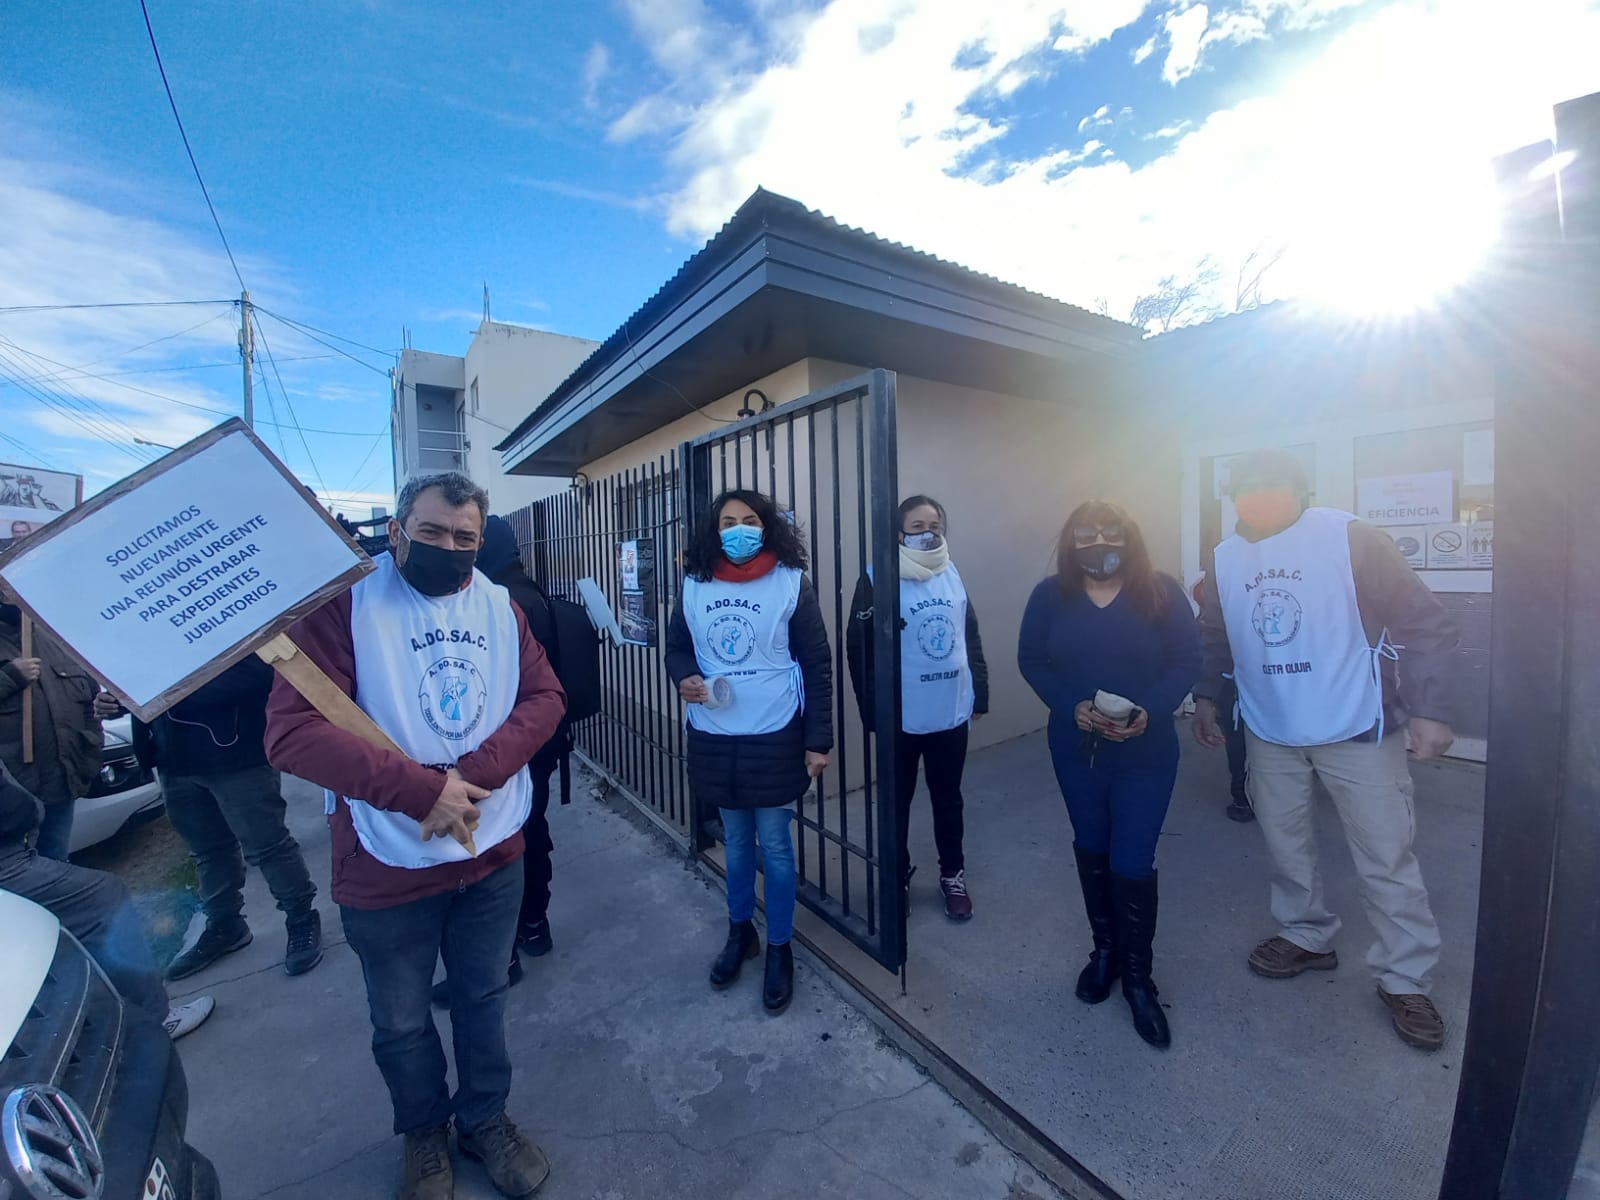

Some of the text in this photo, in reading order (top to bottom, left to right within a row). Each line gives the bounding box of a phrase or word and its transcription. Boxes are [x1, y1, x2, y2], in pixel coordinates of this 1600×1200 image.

[106, 504, 201, 567] SOLICITAMOS
[1367, 506, 1441, 519] EFICIENCIA
[100, 514, 268, 621] UNA REUNIÓN URGENTE
[120, 518, 219, 584] NUEVAMENTE
[139, 543, 262, 622] PARA DESTRABAR
[169, 566, 261, 627] EXPEDIENTES
[184, 579, 278, 644] JUBILATORIOS
